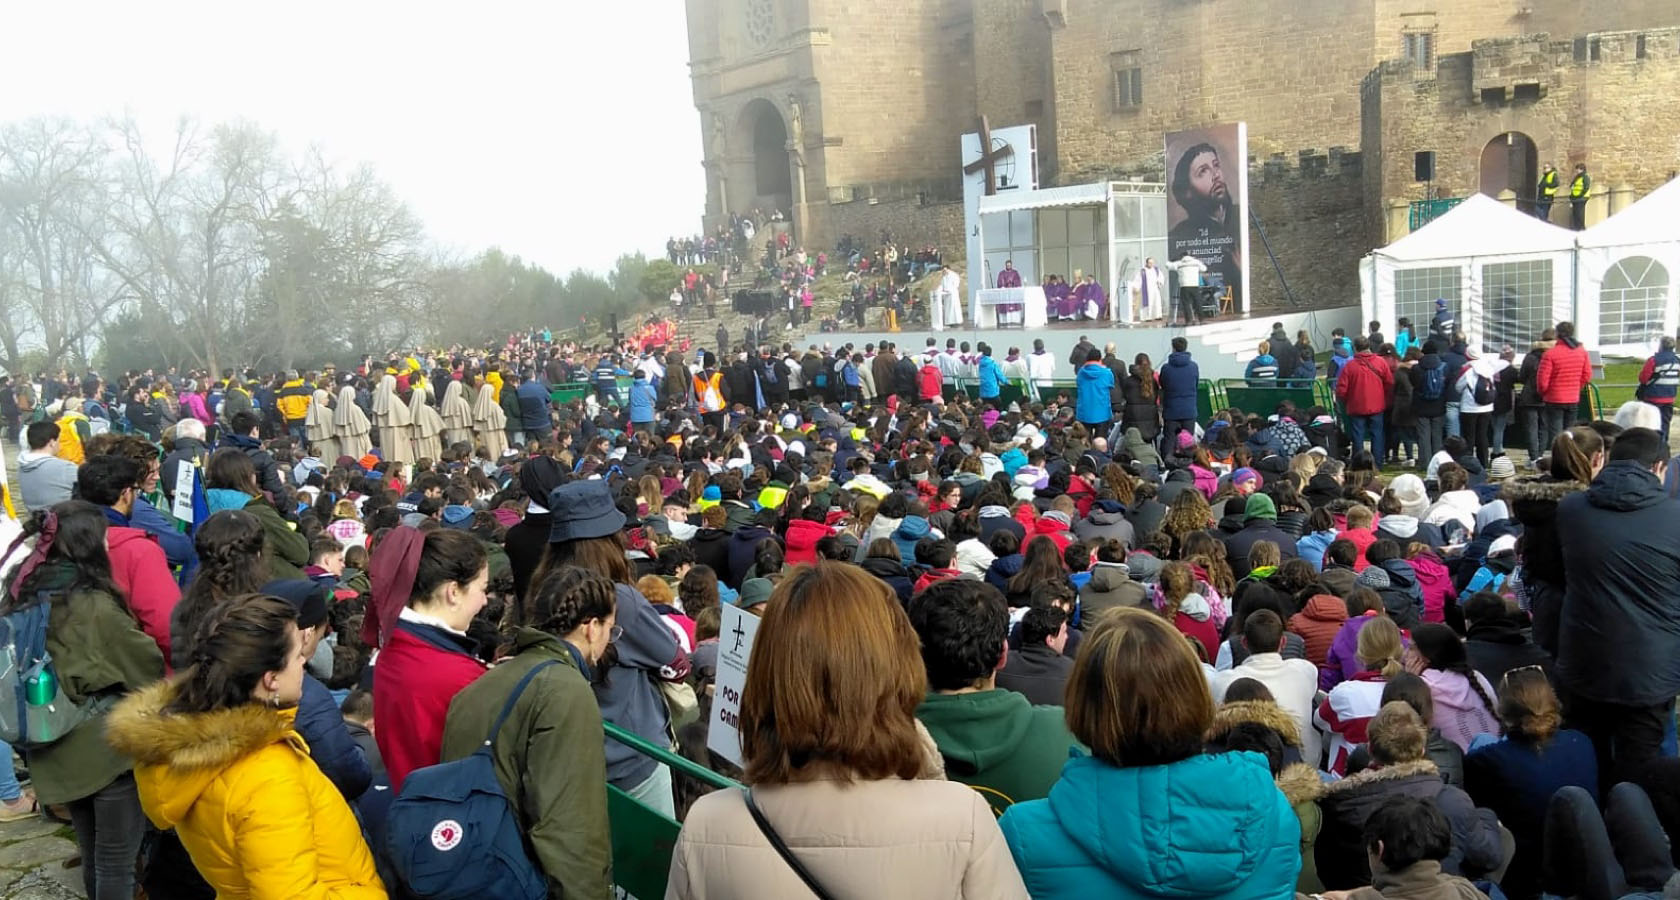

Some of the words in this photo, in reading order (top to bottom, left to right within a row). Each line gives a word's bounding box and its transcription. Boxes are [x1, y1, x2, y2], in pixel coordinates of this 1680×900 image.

[1176, 240, 1185, 249] por
[1187, 238, 1201, 246] todo
[1202, 237, 1208, 245] el
[1210, 236, 1232, 244] mundo
[1192, 246, 1221, 254] anunciad
[723, 685, 739, 705] POR
[720, 708, 738, 728] CAM
